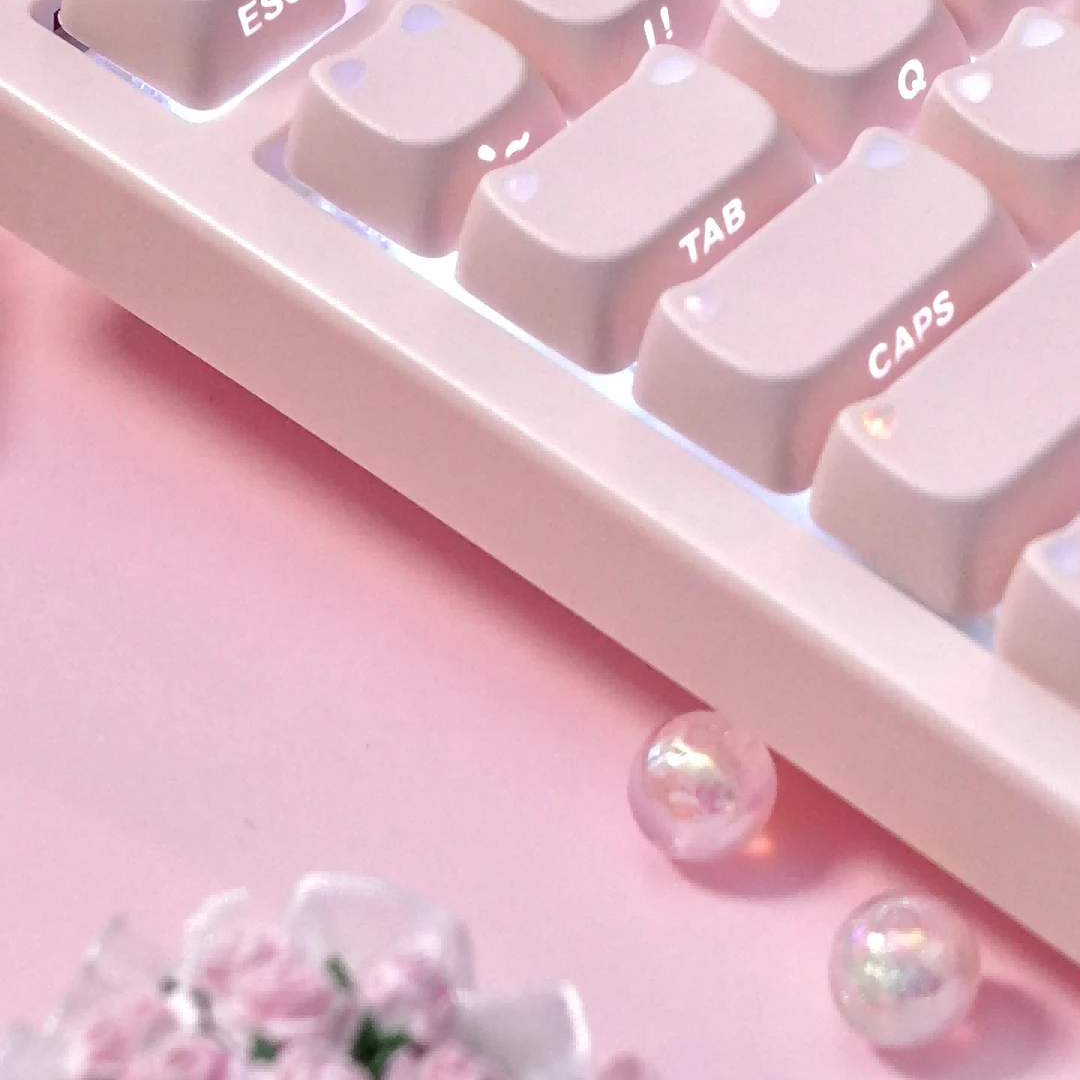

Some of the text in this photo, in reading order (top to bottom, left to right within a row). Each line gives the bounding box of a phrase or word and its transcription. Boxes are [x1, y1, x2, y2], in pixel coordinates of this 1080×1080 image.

[897, 58, 927, 100] Q
[678, 197, 747, 264] TAB
[867, 290, 956, 379] CAPS
